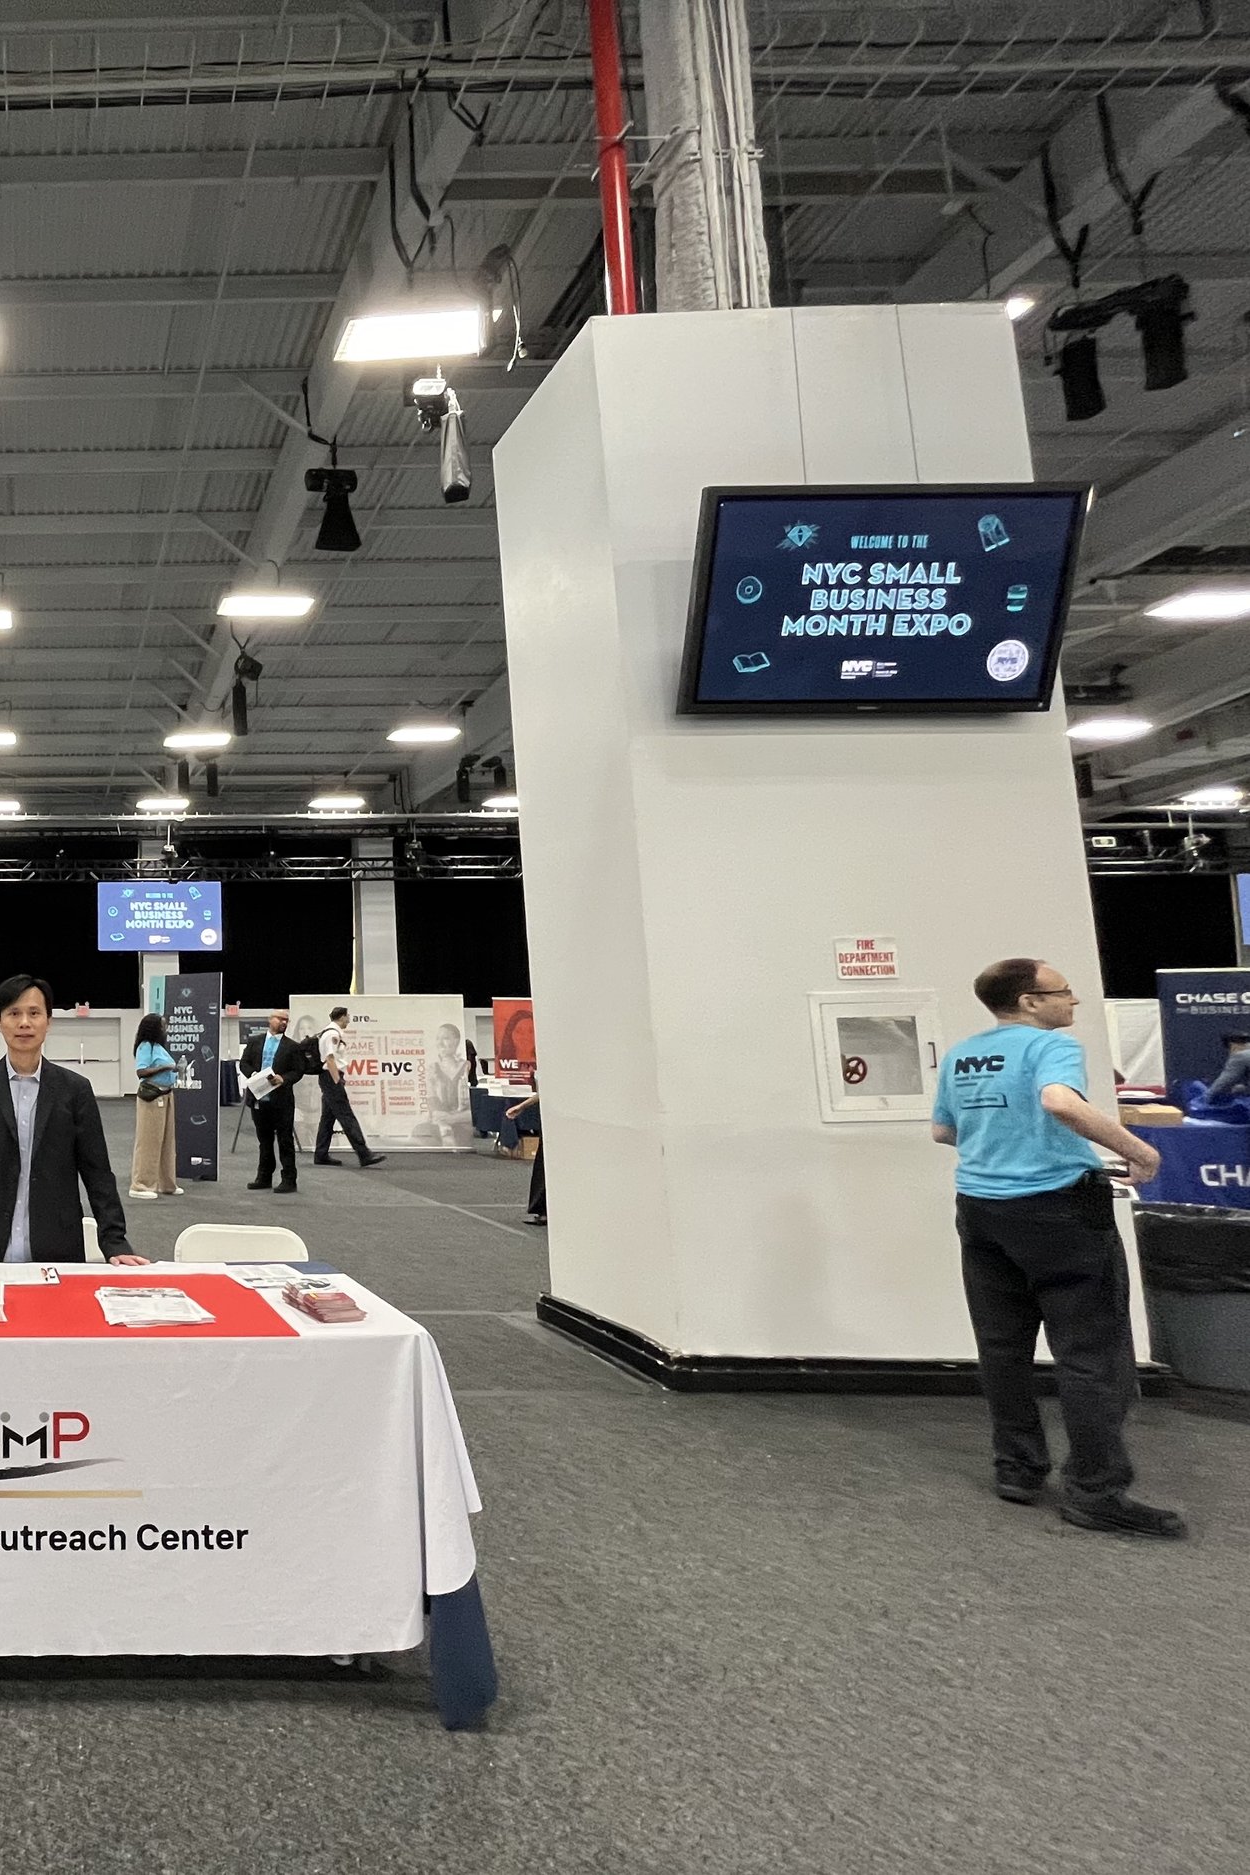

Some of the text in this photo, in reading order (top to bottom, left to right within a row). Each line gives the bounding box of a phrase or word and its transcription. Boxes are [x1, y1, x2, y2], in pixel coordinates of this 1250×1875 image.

[851, 534, 929, 549] WELCOME TO THE
[802, 562, 961, 585] NYC SMALL
[810, 588, 947, 611] BUSINESS
[781, 613, 972, 637] MONTH EXPO
[130, 902, 187, 911] NYC SMALL
[134, 911, 184, 920] BUSINESS
[126, 920, 194, 929] MONTH EXPO
[856, 939, 875, 950] FIRE
[838, 952, 895, 964] DEPARTMENT
[841, 965, 895, 976] CONNECTION
[1176, 993, 1238, 1004] CHASE
[174, 1006, 193, 1015] NYC
[169, 1015, 198, 1024] SMALL
[166, 1024, 205, 1033] USINESS
[166, 1034, 200, 1042] MONTH
[170, 1043, 195, 1052] EXPO
[500, 1059, 519, 1069] WE
[954, 1055, 1005, 1075] NYC
[417, 1058, 428, 1115] POWERFUL
[1200, 1165, 1250, 1187] CH
[136, 1523, 249, 1551] Center
